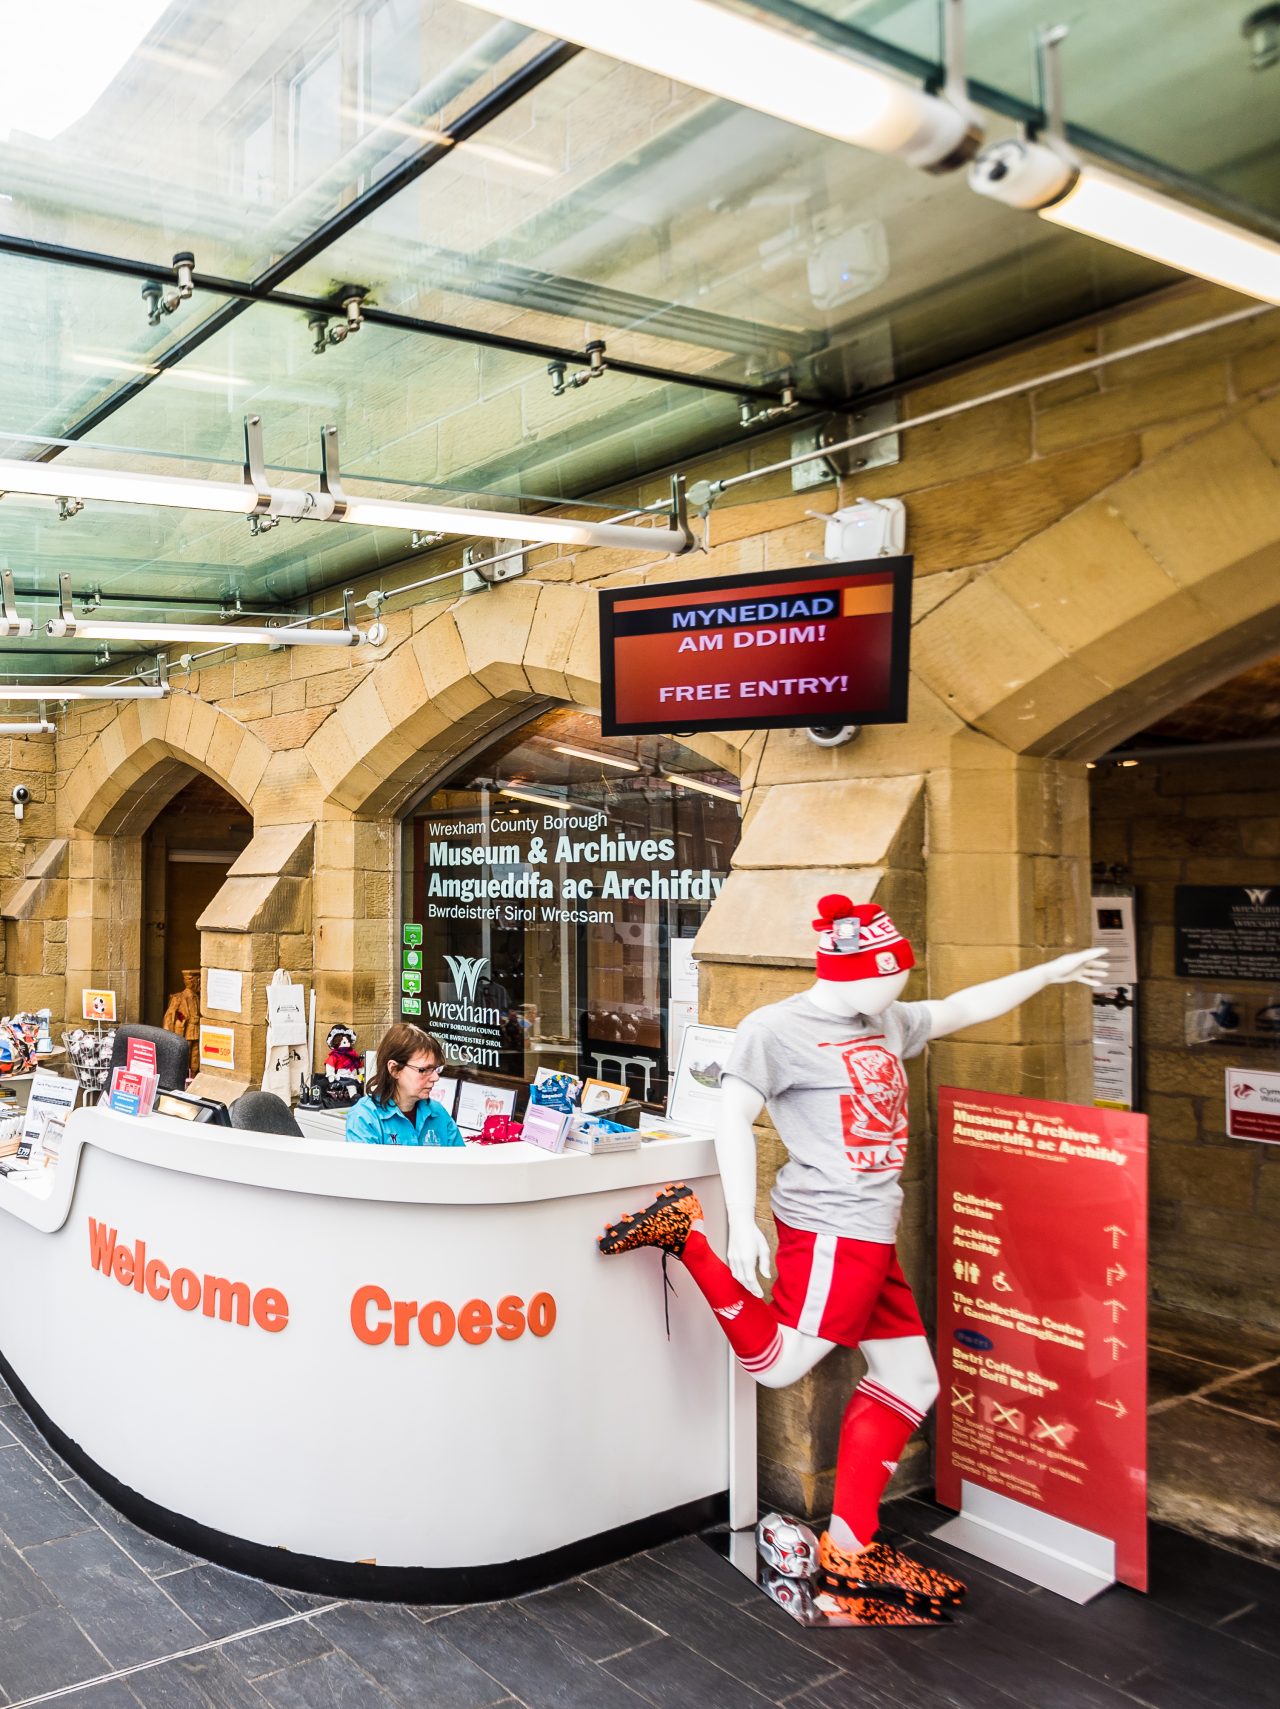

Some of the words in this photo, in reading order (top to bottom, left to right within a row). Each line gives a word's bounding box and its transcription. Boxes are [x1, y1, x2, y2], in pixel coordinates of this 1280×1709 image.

[672, 598, 834, 628] MYNEDIAD
[678, 634, 723, 653] AM
[733, 625, 826, 648] DDIM!
[659, 683, 731, 702] FREE
[739, 675, 849, 699] ENTRY!
[429, 820, 487, 837] Wrexham
[491, 817, 539, 834] County
[543, 812, 608, 832] Borough
[429, 841, 520, 867] Museum
[527, 836, 548, 864] &
[554, 833, 675, 864] Archives
[428, 872, 554, 902] Amgueddfa
[562, 879, 593, 900] ac
[428, 904, 500, 921] Bwrdeistref
[504, 907, 536, 922] Sirol
[542, 908, 614, 924] Wrecsam
[428, 997, 501, 1026] wrexham
[429, 1020, 449, 1029] COUNTY
[450, 1024, 476, 1033] BOROUGH
[477, 1028, 500, 1036] COUNCIL
[450, 1034, 485, 1045] BWRDEISTREF
[486, 1040, 502, 1048] SIROL
[953, 1109, 1014, 1130] Museum
[1016, 1118, 1031, 1133] &
[1032, 1121, 1101, 1145] Archives
[953, 1123, 1034, 1148] Amgueddfa
[1036, 1139, 1057, 1152] ac
[1058, 1140, 1128, 1166] Archifdy
[953, 1191, 1003, 1211] Galleries
[953, 1203, 994, 1220] Orielau
[953, 1225, 1001, 1245] Archives
[953, 1236, 1000, 1257] Archifdy
[88, 1216, 290, 1333] Welcome
[350, 1284, 557, 1347] Croeso
[952, 1291, 973, 1306] The
[975, 1298, 1041, 1325] Collections
[1041, 1316, 1085, 1338] Centre
[952, 1302, 961, 1313] Y
[963, 1306, 1015, 1330] Ganolfan
[952, 1347, 983, 1365] Bwtri
[985, 1358, 1025, 1380] Coffee
[1026, 1371, 1059, 1391] Shop
[952, 1358, 978, 1376] Siop
[1010, 1378, 1045, 1398] Bwtri
